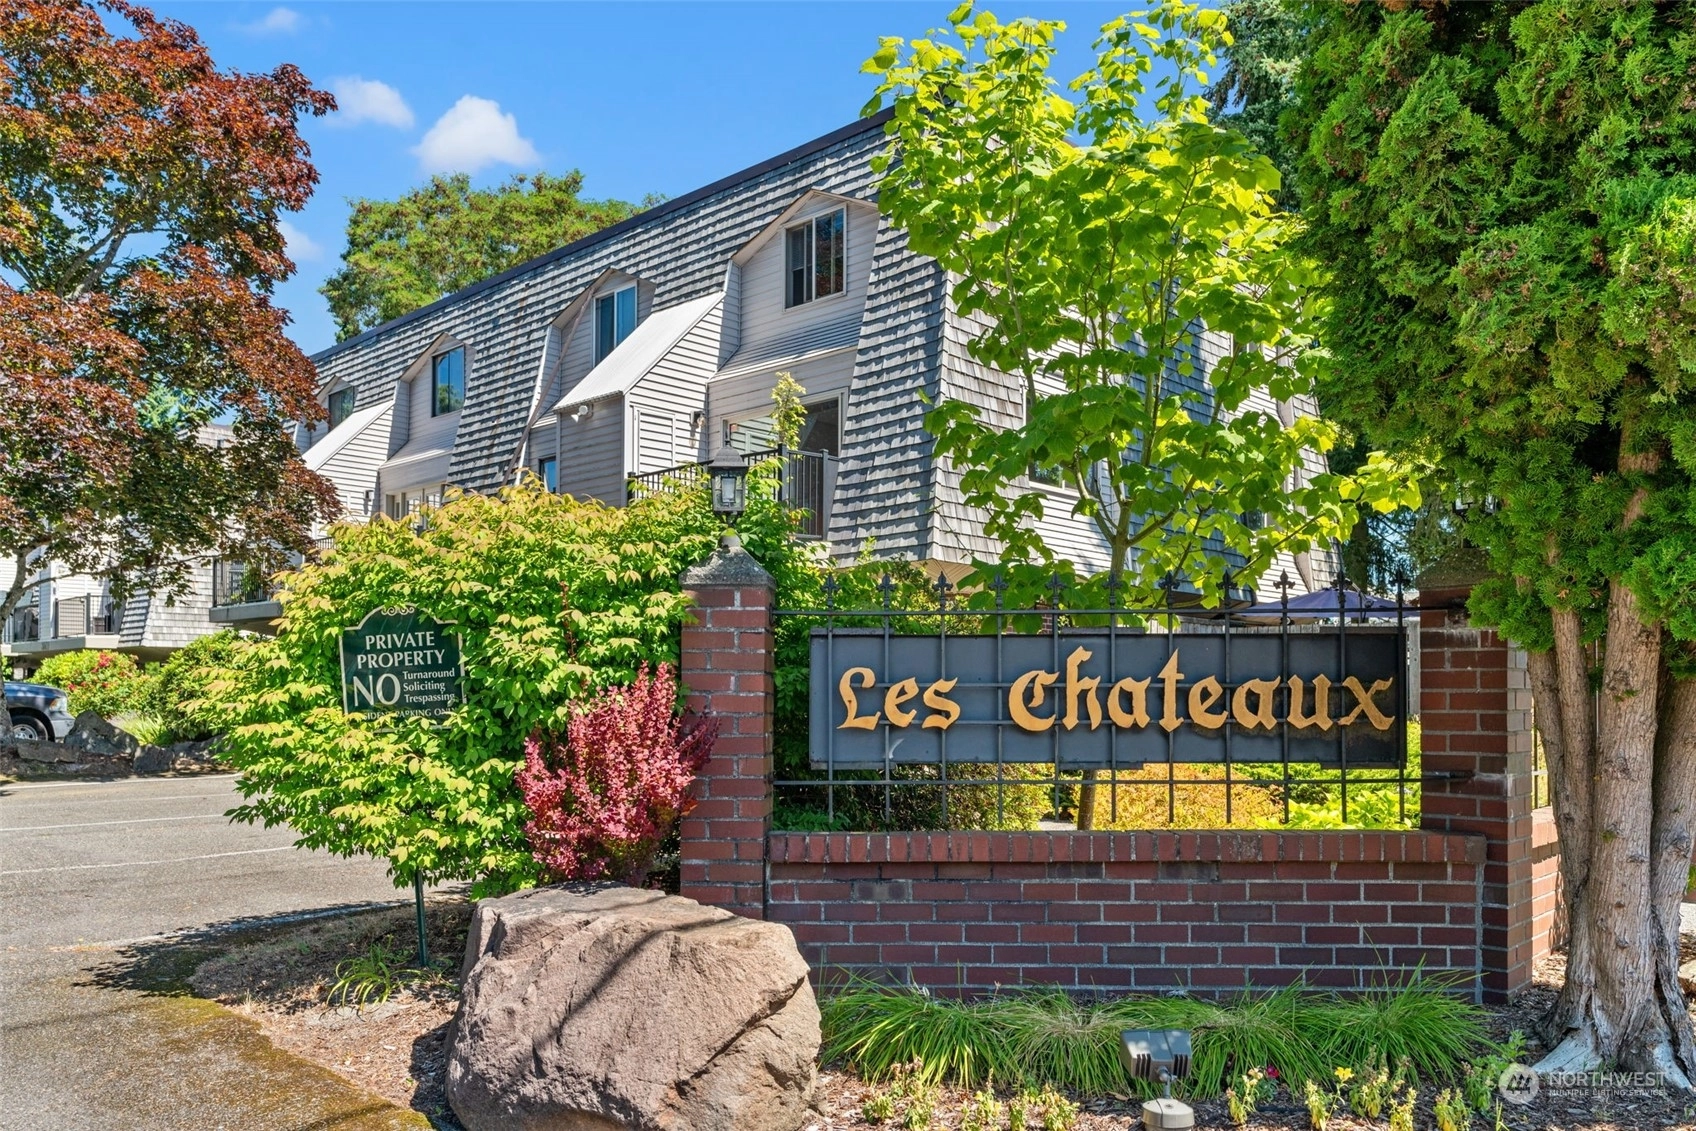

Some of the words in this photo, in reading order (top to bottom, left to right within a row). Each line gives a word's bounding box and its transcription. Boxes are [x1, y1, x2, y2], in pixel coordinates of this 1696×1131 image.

[365, 631, 435, 650] PRIVATE
[357, 649, 445, 669] PROPERTY
[402, 667, 455, 680] Turnaround
[353, 673, 401, 707] NO
[403, 681, 446, 693] Soliciting
[836, 666, 961, 731] Les
[1008, 645, 1396, 733] Chateaux
[404, 692, 455, 704] Trespassing
